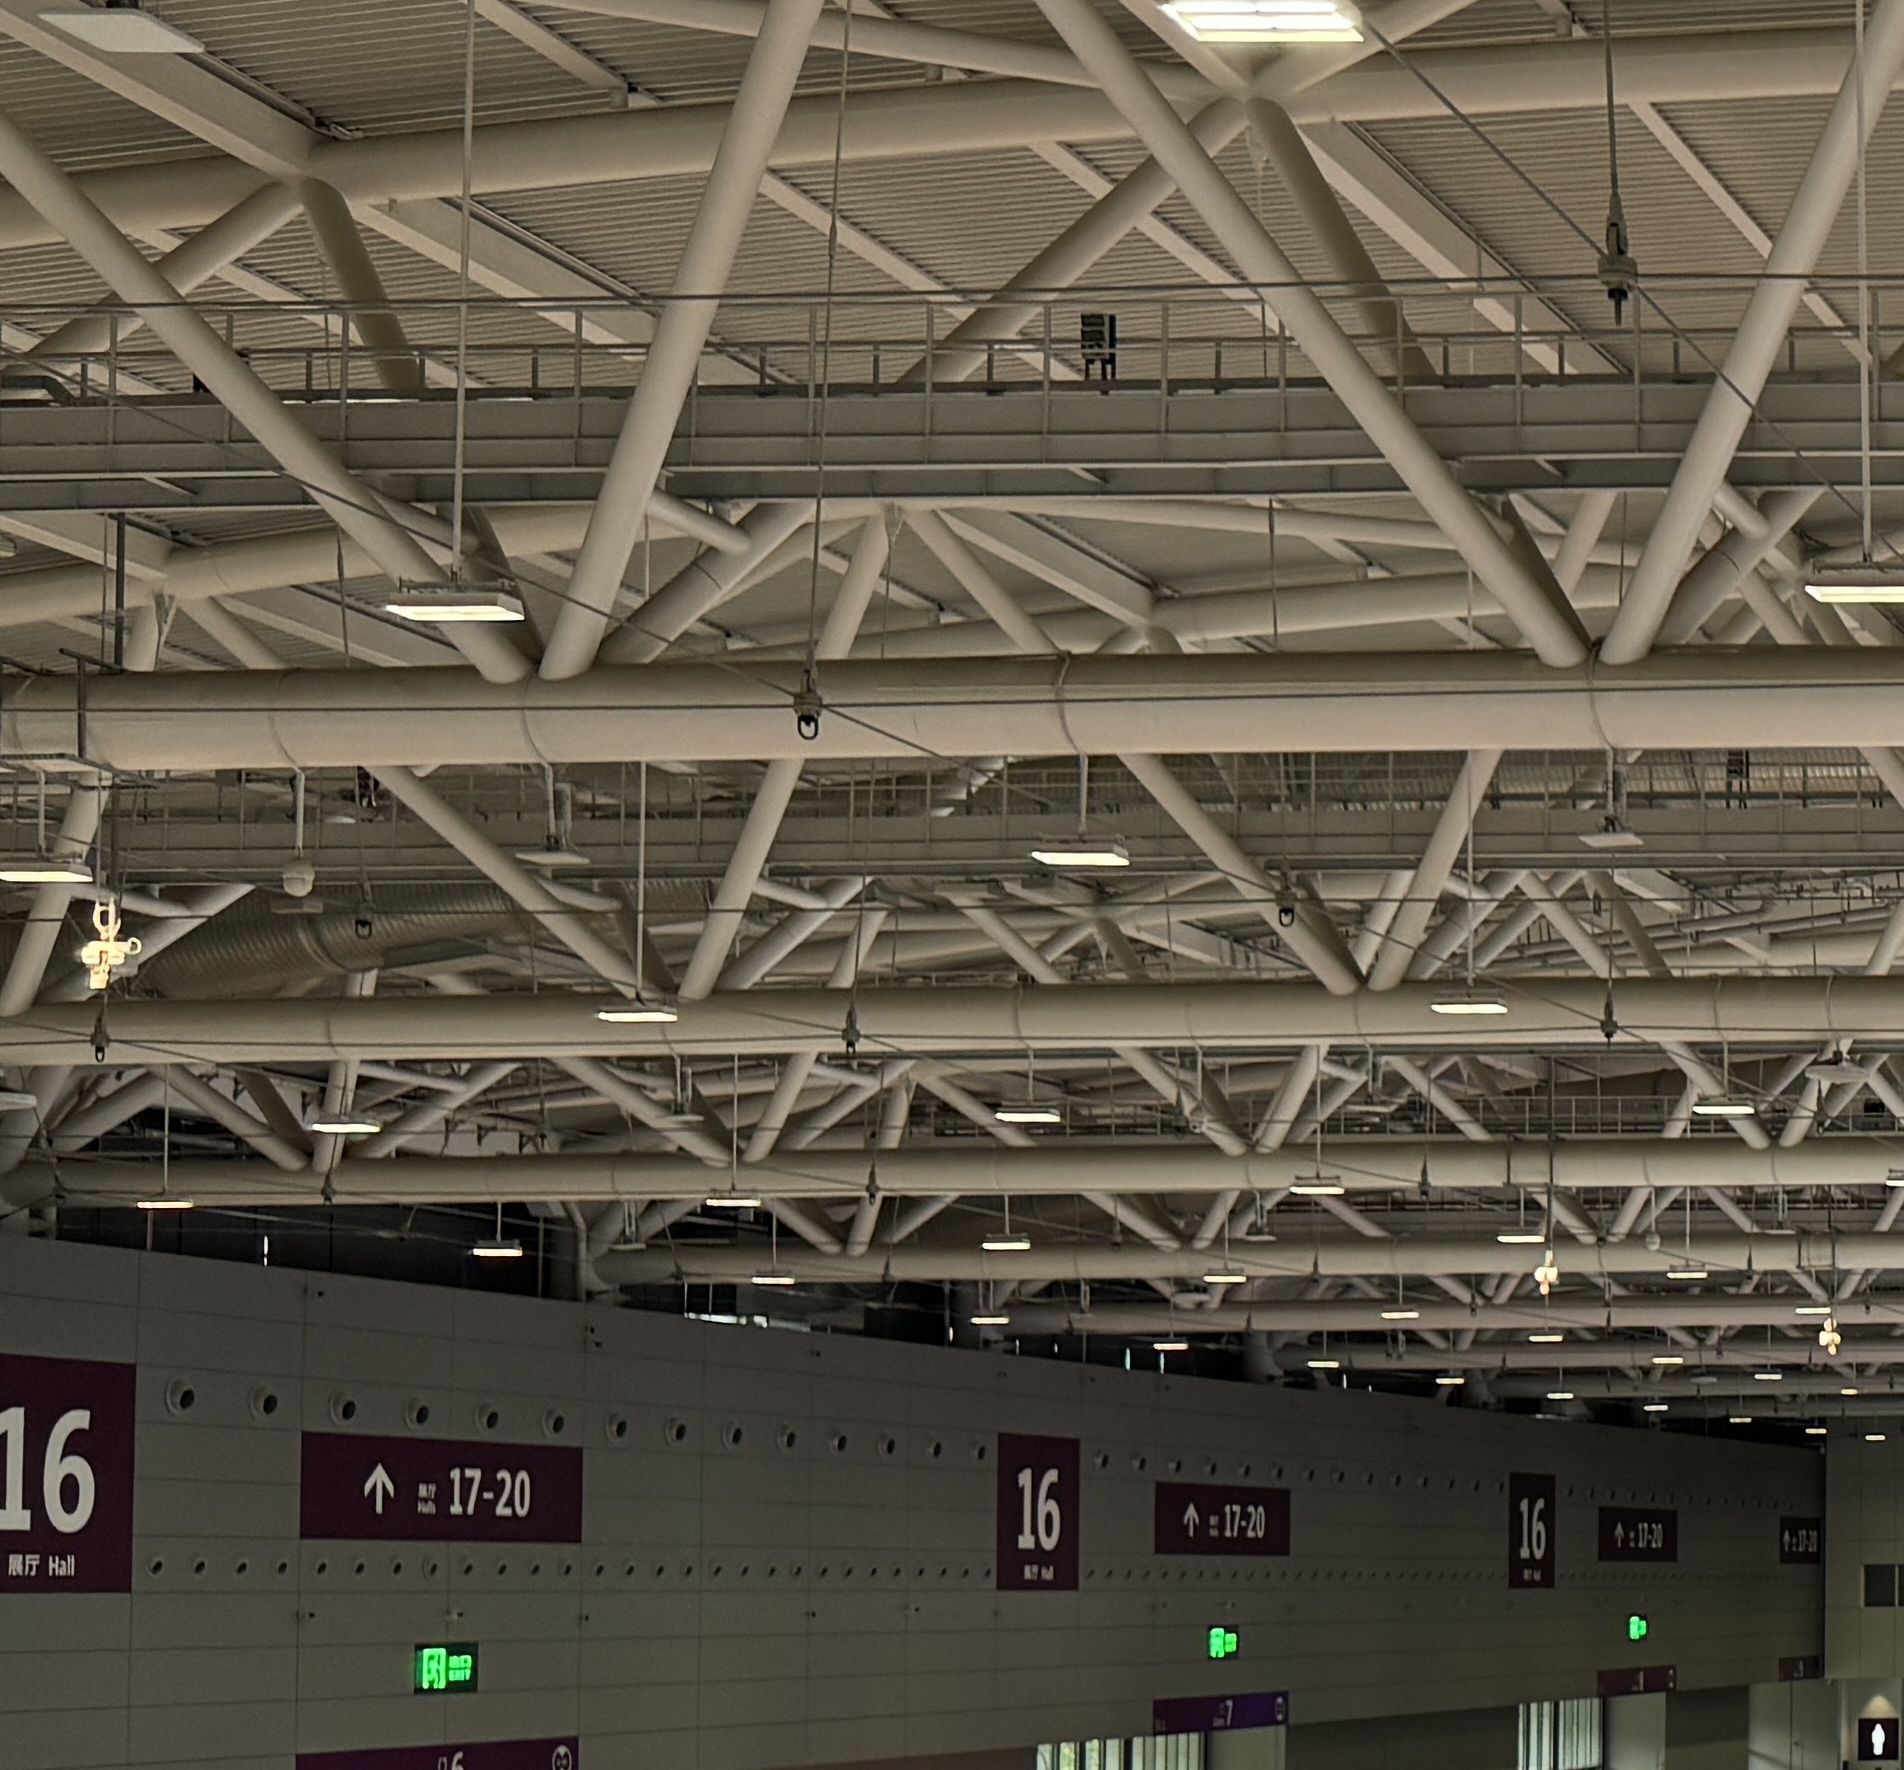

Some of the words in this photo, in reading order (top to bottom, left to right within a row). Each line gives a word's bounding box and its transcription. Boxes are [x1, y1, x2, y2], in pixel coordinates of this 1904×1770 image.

[0, 1406, 95, 1534] 16
[449, 1466, 531, 1517] 17-20
[1017, 1467, 1061, 1551] 16
[1224, 1504, 1266, 1538] 17-20
[1520, 1497, 1546, 1560] 16
[8, 1554, 40, 1577] 展厅
[48, 1554, 76, 1577] Hall
